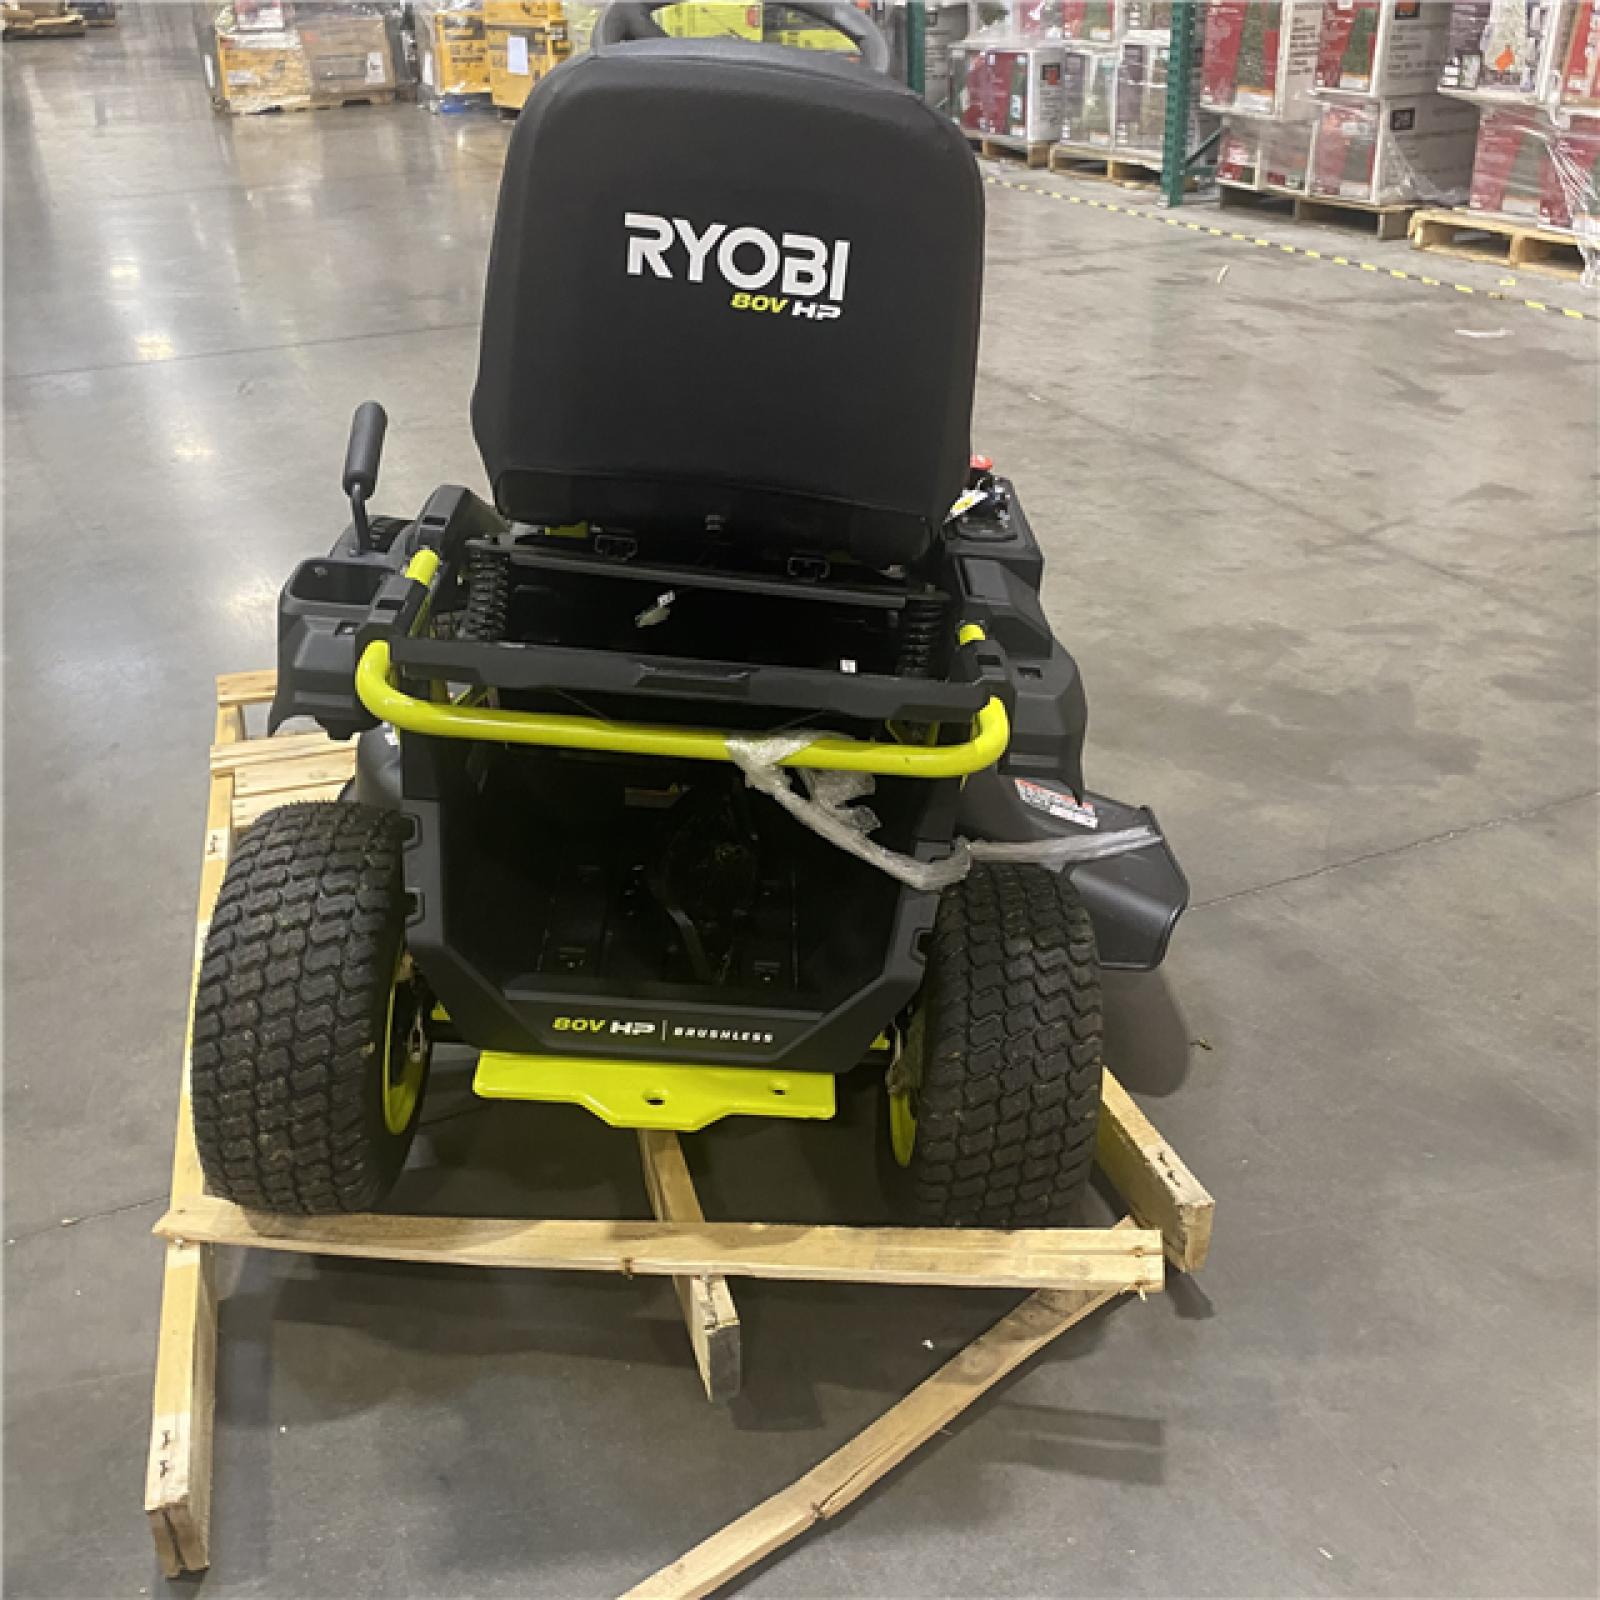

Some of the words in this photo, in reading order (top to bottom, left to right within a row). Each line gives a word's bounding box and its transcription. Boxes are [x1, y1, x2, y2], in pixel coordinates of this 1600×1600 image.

[624, 211, 850, 301] RYOBI
[730, 292, 788, 313] 80V
[791, 300, 841, 320] HP
[552, 1017, 606, 1032] 80V
[609, 1019, 656, 1035] HP
